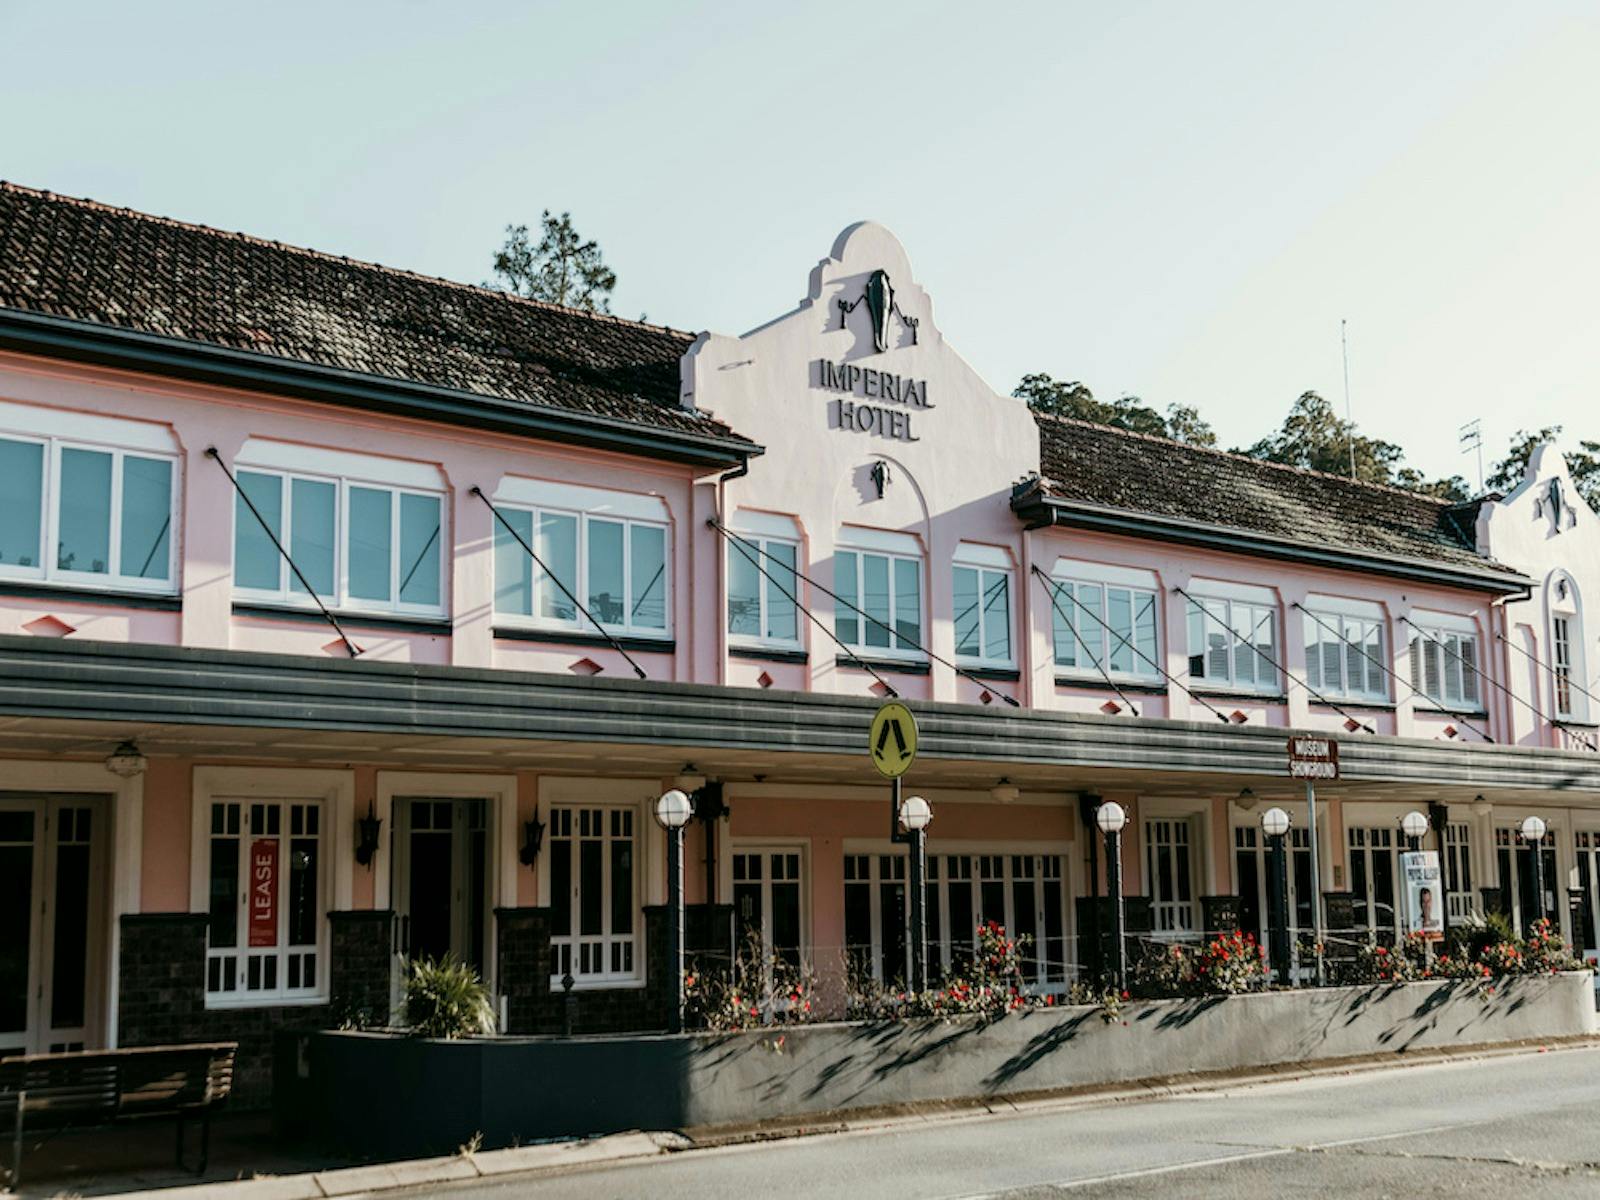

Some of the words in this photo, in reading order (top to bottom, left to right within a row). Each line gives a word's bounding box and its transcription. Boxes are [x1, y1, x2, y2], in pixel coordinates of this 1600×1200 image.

[819, 358, 936, 409] IMPERIAL
[836, 399, 920, 441] HOTEL
[1294, 740, 1330, 756] MUSEUM
[255, 854, 272, 920] LEASE
